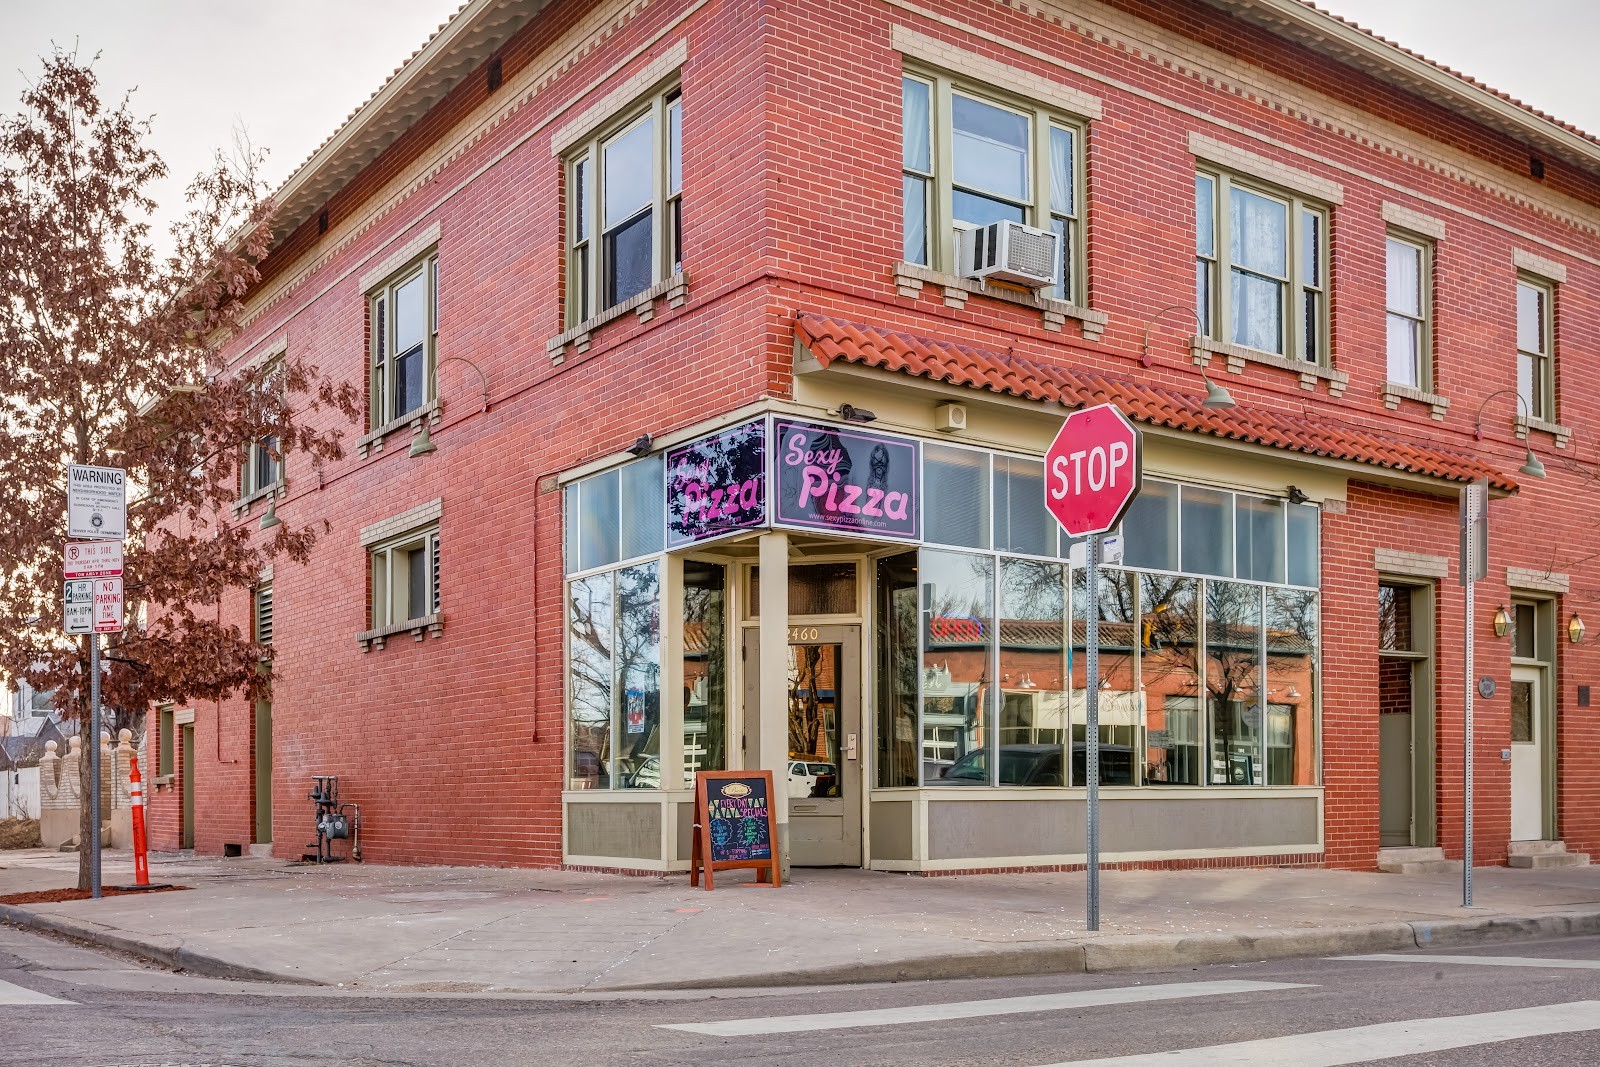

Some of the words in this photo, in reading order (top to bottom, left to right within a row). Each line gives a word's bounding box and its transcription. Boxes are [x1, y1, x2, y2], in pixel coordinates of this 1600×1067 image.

[785, 433, 843, 474] Sexy
[72, 468, 122, 485] WARNING
[1051, 441, 1129, 500] STOP
[798, 466, 909, 521] Pizza
[682, 477, 759, 527] Pizza
[808, 512, 887, 528] www.sexypizzaonline.com
[84, 547, 96, 556] THIS
[100, 546, 112, 555] SIDE
[66, 585, 72, 601] 2
[77, 583, 87, 592] HR
[103, 581, 114, 592] NO
[72, 591, 92, 601] PARKING
[95, 593, 121, 605] PARKING
[931, 615, 979, 643] OPEN
[740, 808, 768, 818] SPECIALS
